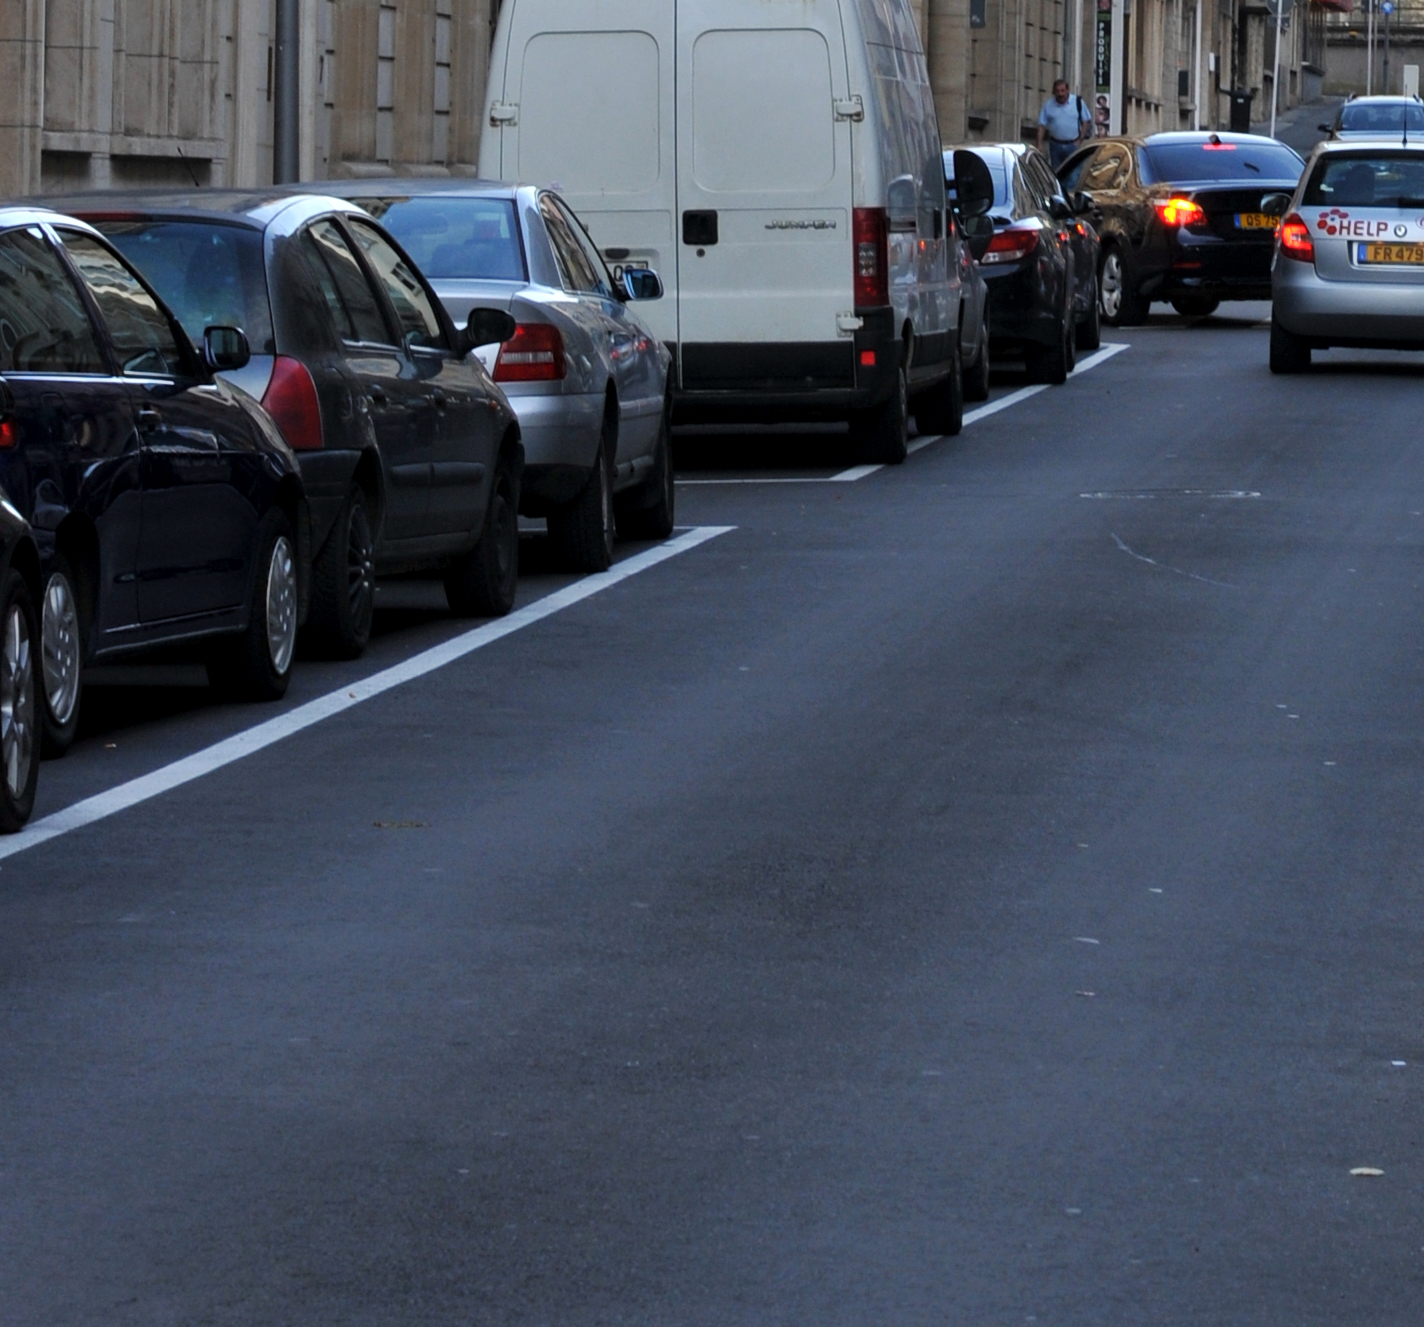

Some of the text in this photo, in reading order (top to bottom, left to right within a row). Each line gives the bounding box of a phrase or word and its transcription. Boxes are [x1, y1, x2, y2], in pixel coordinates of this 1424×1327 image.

[764, 220, 836, 230] JUMPER
[1246, 214, 1262, 226] QS
[1339, 220, 1388, 237] HELP
[1373, 246, 1393, 262] FR
